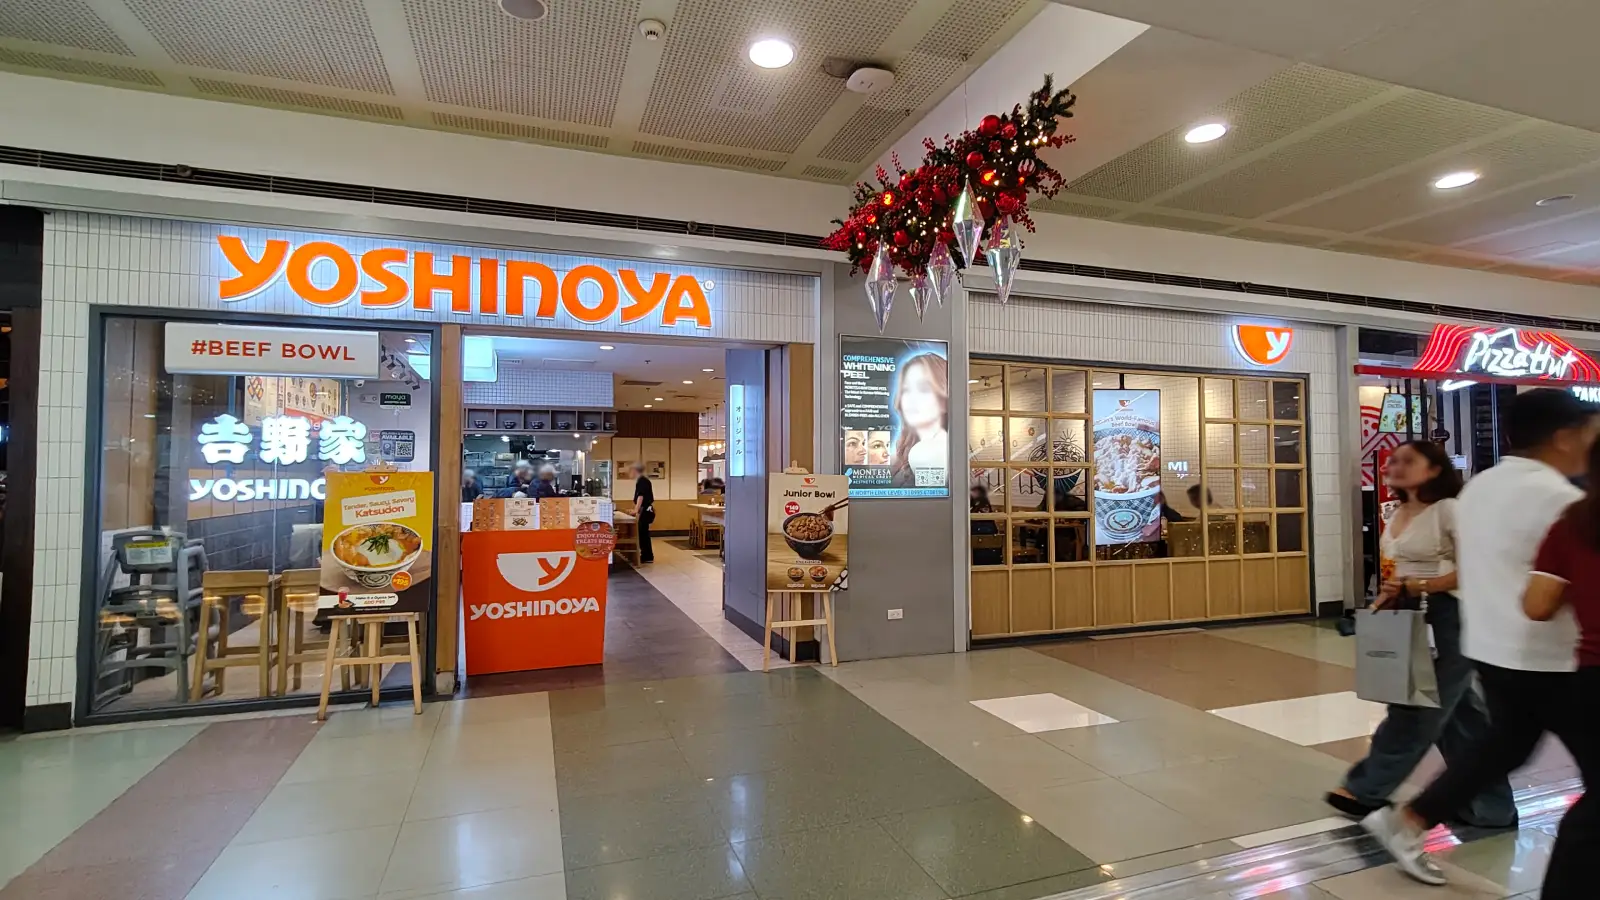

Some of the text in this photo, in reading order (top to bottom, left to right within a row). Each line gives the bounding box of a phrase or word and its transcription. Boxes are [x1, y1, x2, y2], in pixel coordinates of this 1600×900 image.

[217, 235, 712, 329] YOSHINOYA
[191, 340, 355, 361] #BEEF BOWL
[1464, 331, 1578, 378] Pizza Hut
[843, 354, 894, 364] COMPREHENSIVE
[843, 362, 896, 372] WHITENING
[843, 370, 869, 379] PEEL
[1572, 386, 1600, 404] TAK
[852, 468, 891, 476] MONTESA
[783, 489, 836, 498] Junior Bowl
[344, 502, 369, 511] Tender,
[355, 505, 404, 518] Katsudon
[470, 597, 600, 621] YOSHINOYA
